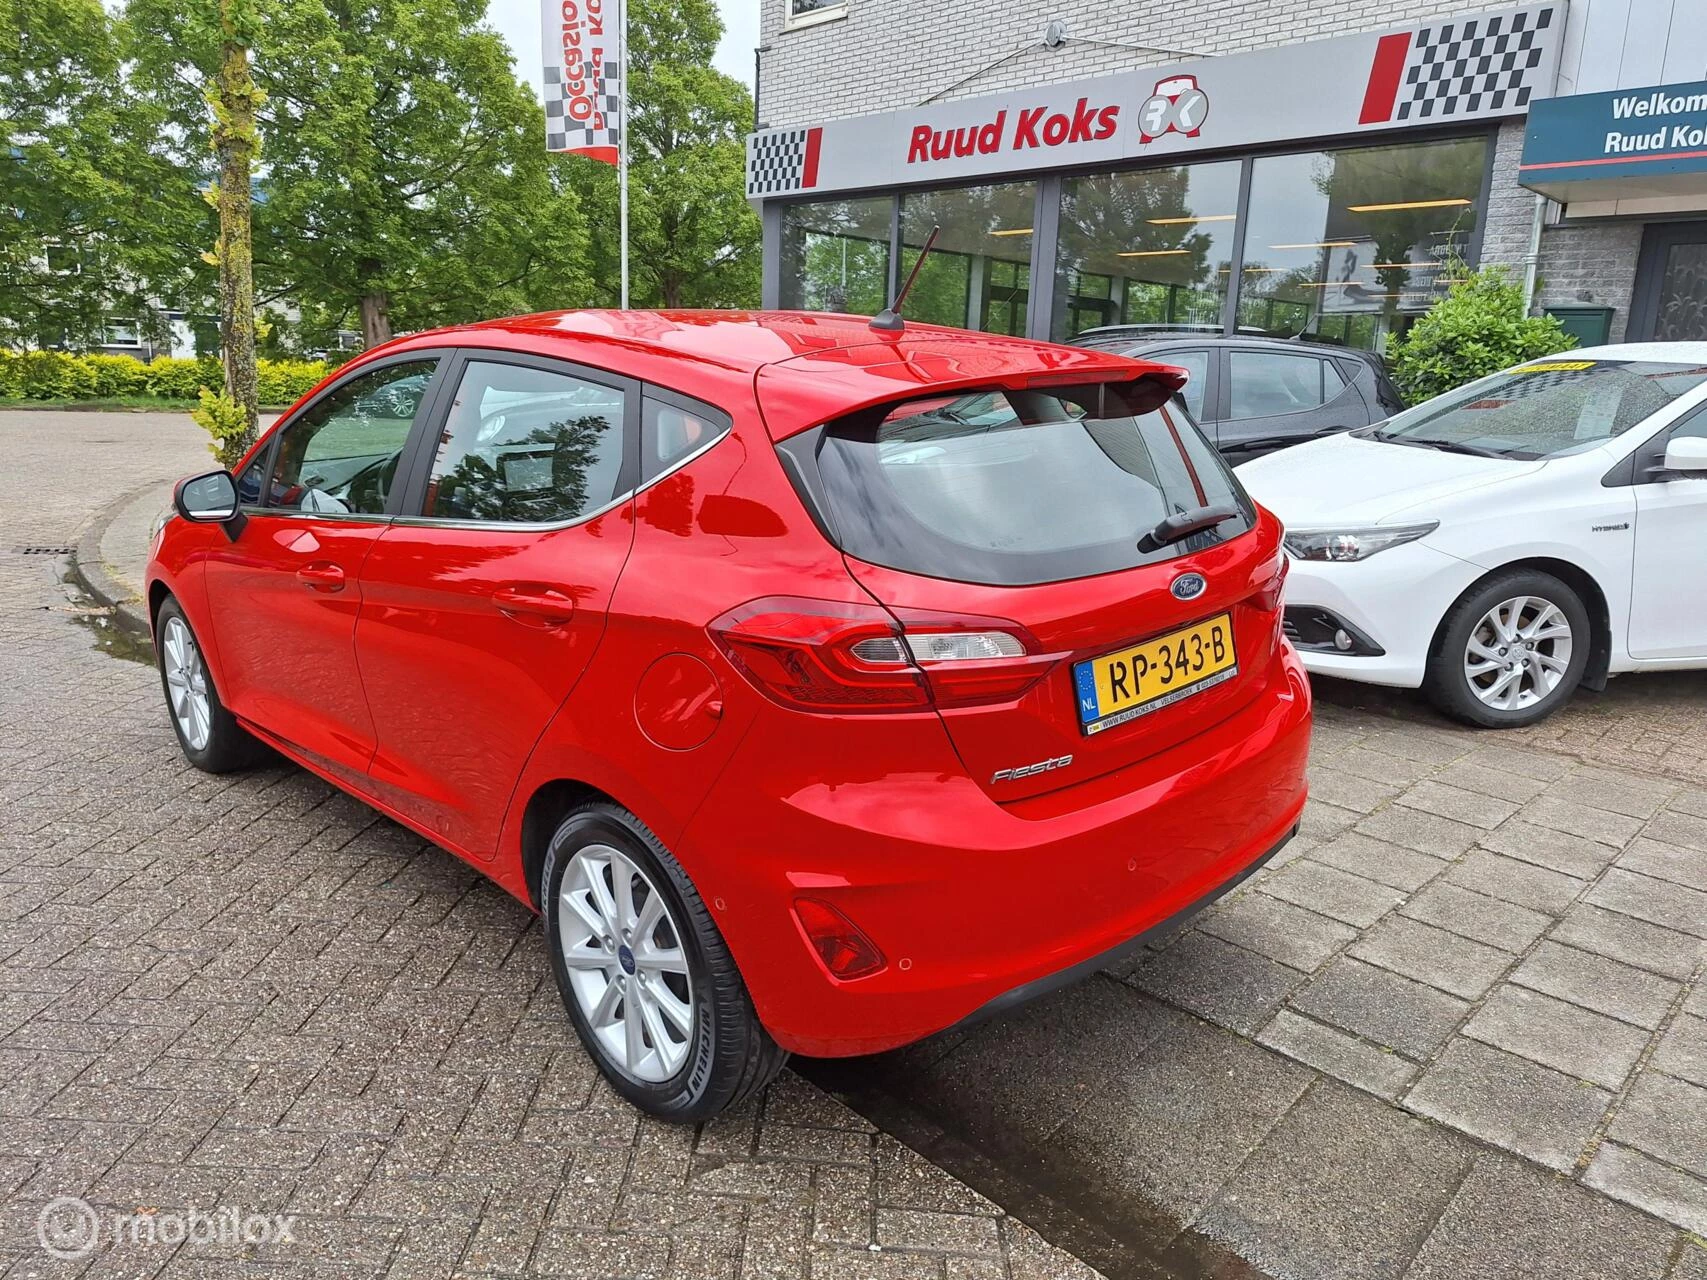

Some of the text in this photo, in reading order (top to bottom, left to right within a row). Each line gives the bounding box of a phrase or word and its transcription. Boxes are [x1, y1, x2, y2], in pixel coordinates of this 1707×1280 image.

[1613, 92, 1707, 119] Welkom
[907, 97, 1120, 163] Ruud Koks
[1604, 126, 1667, 153] Ruud
[1180, 577, 1200, 596] Ford
[1109, 625, 1226, 703] RP-343-B
[1082, 697, 1096, 712] NL
[991, 754, 1073, 784] Fiesta
[691, 1007, 711, 1091] MICHELIN
